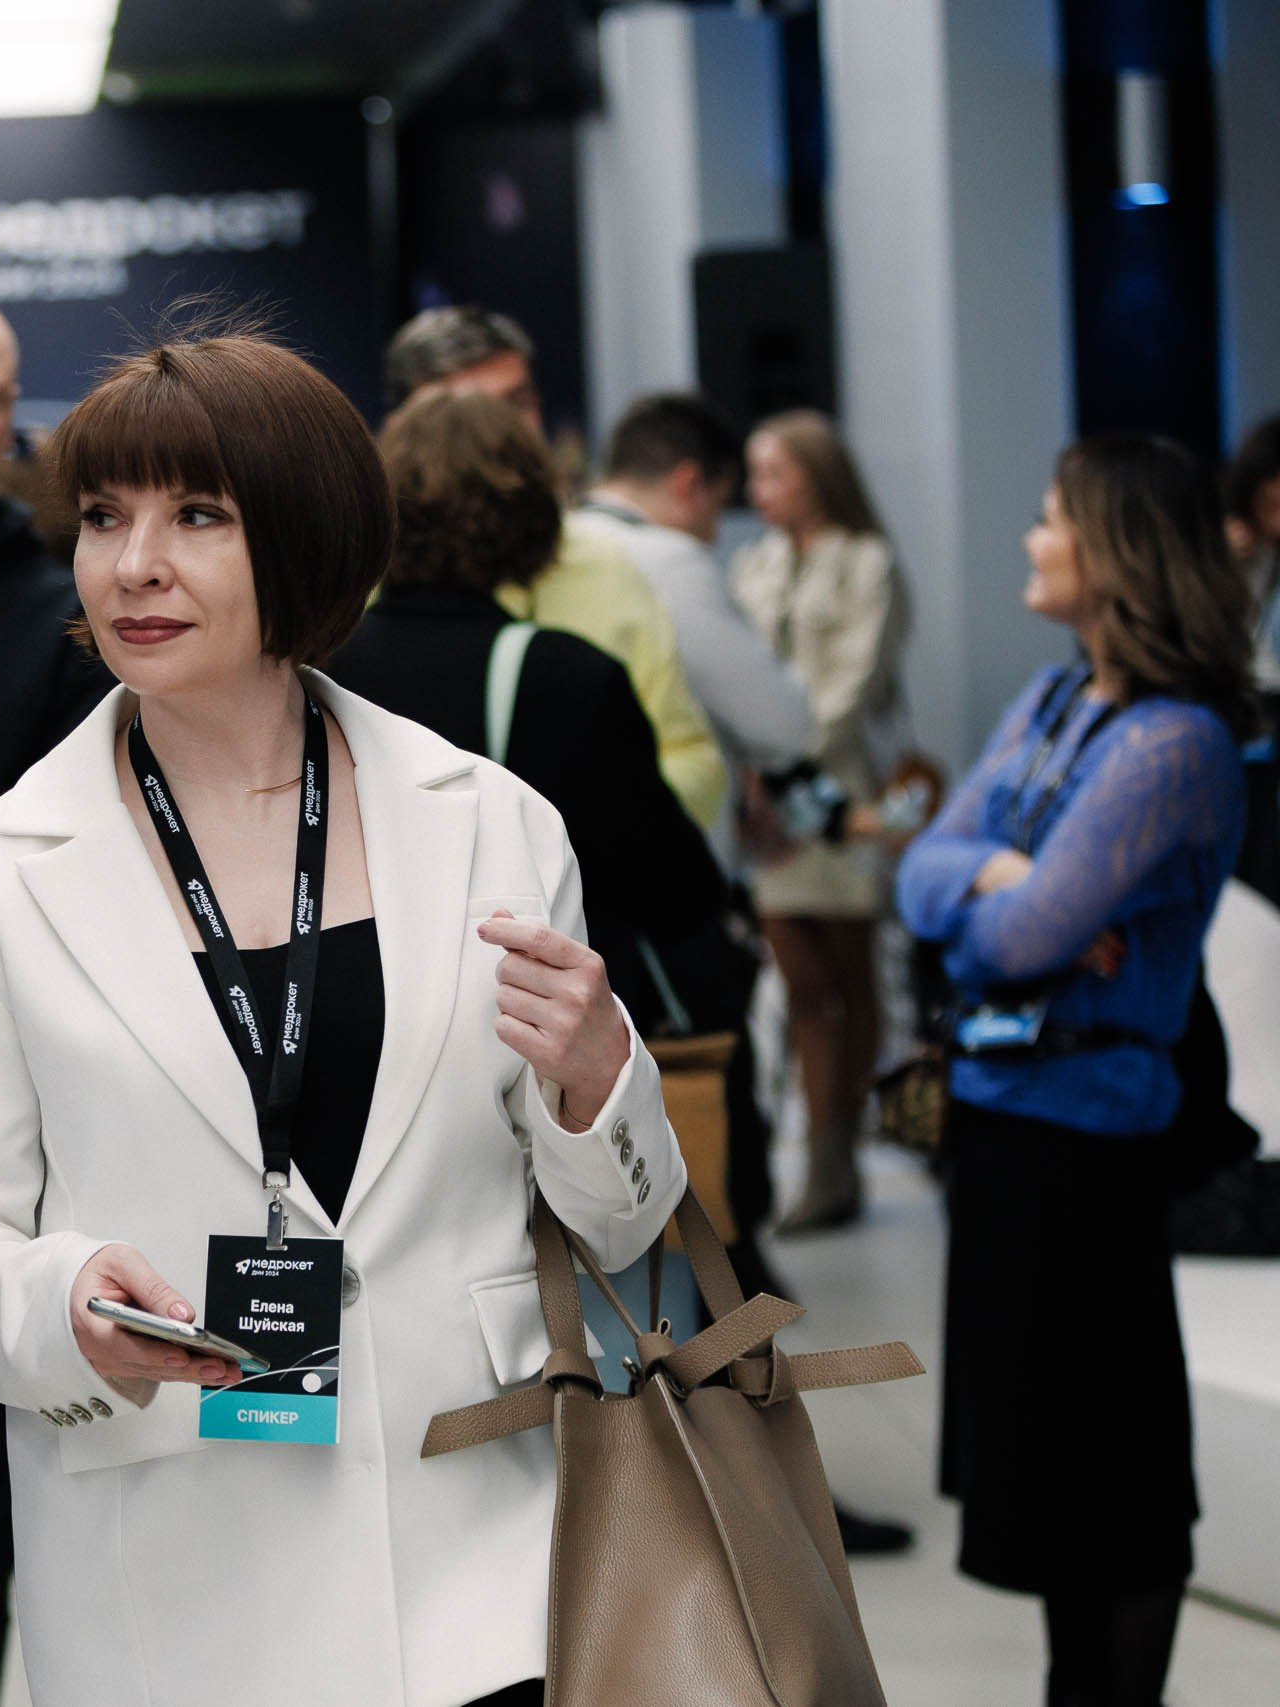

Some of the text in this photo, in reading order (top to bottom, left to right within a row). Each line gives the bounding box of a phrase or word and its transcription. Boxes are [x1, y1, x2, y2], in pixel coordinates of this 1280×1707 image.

[250, 1299, 294, 1314] Елена
[239, 1316, 305, 1333] Шуйская
[237, 1409, 299, 1425] СПИКЕР
